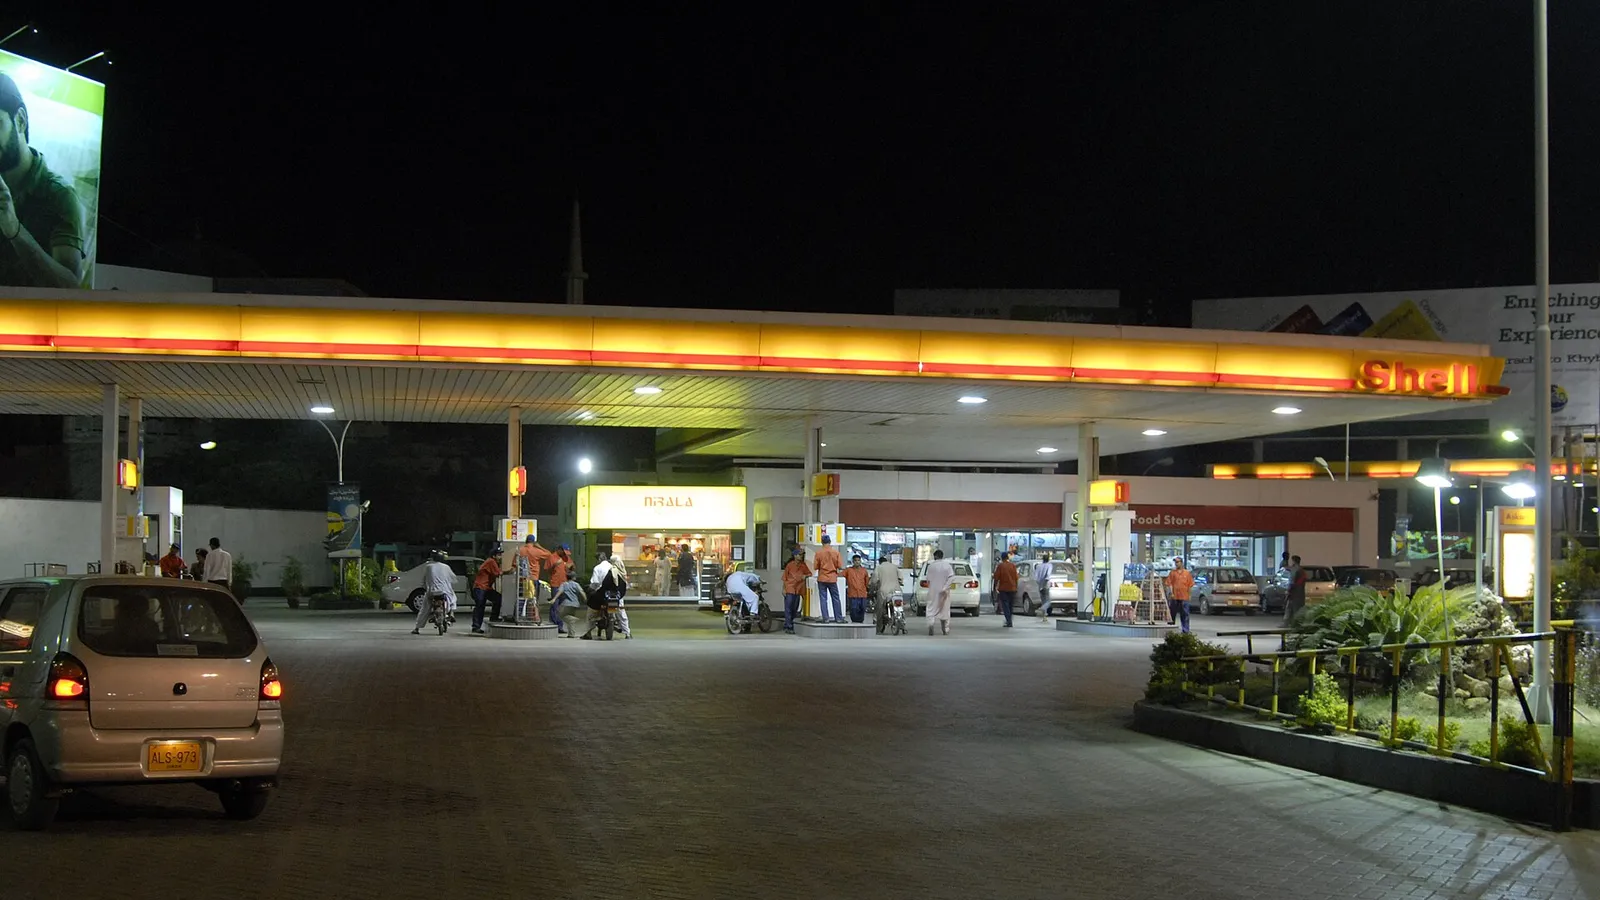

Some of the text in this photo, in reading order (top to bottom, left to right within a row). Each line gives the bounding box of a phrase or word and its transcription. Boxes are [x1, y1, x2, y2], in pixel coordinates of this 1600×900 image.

[1503, 292, 1600, 310] Enching
[1498, 326, 1600, 344] Exprienc
[1361, 360, 1477, 394] Shell
[828, 476, 834, 491] 2
[1164, 515, 1195, 526] Store
[151, 751, 197, 763] ALS-973
